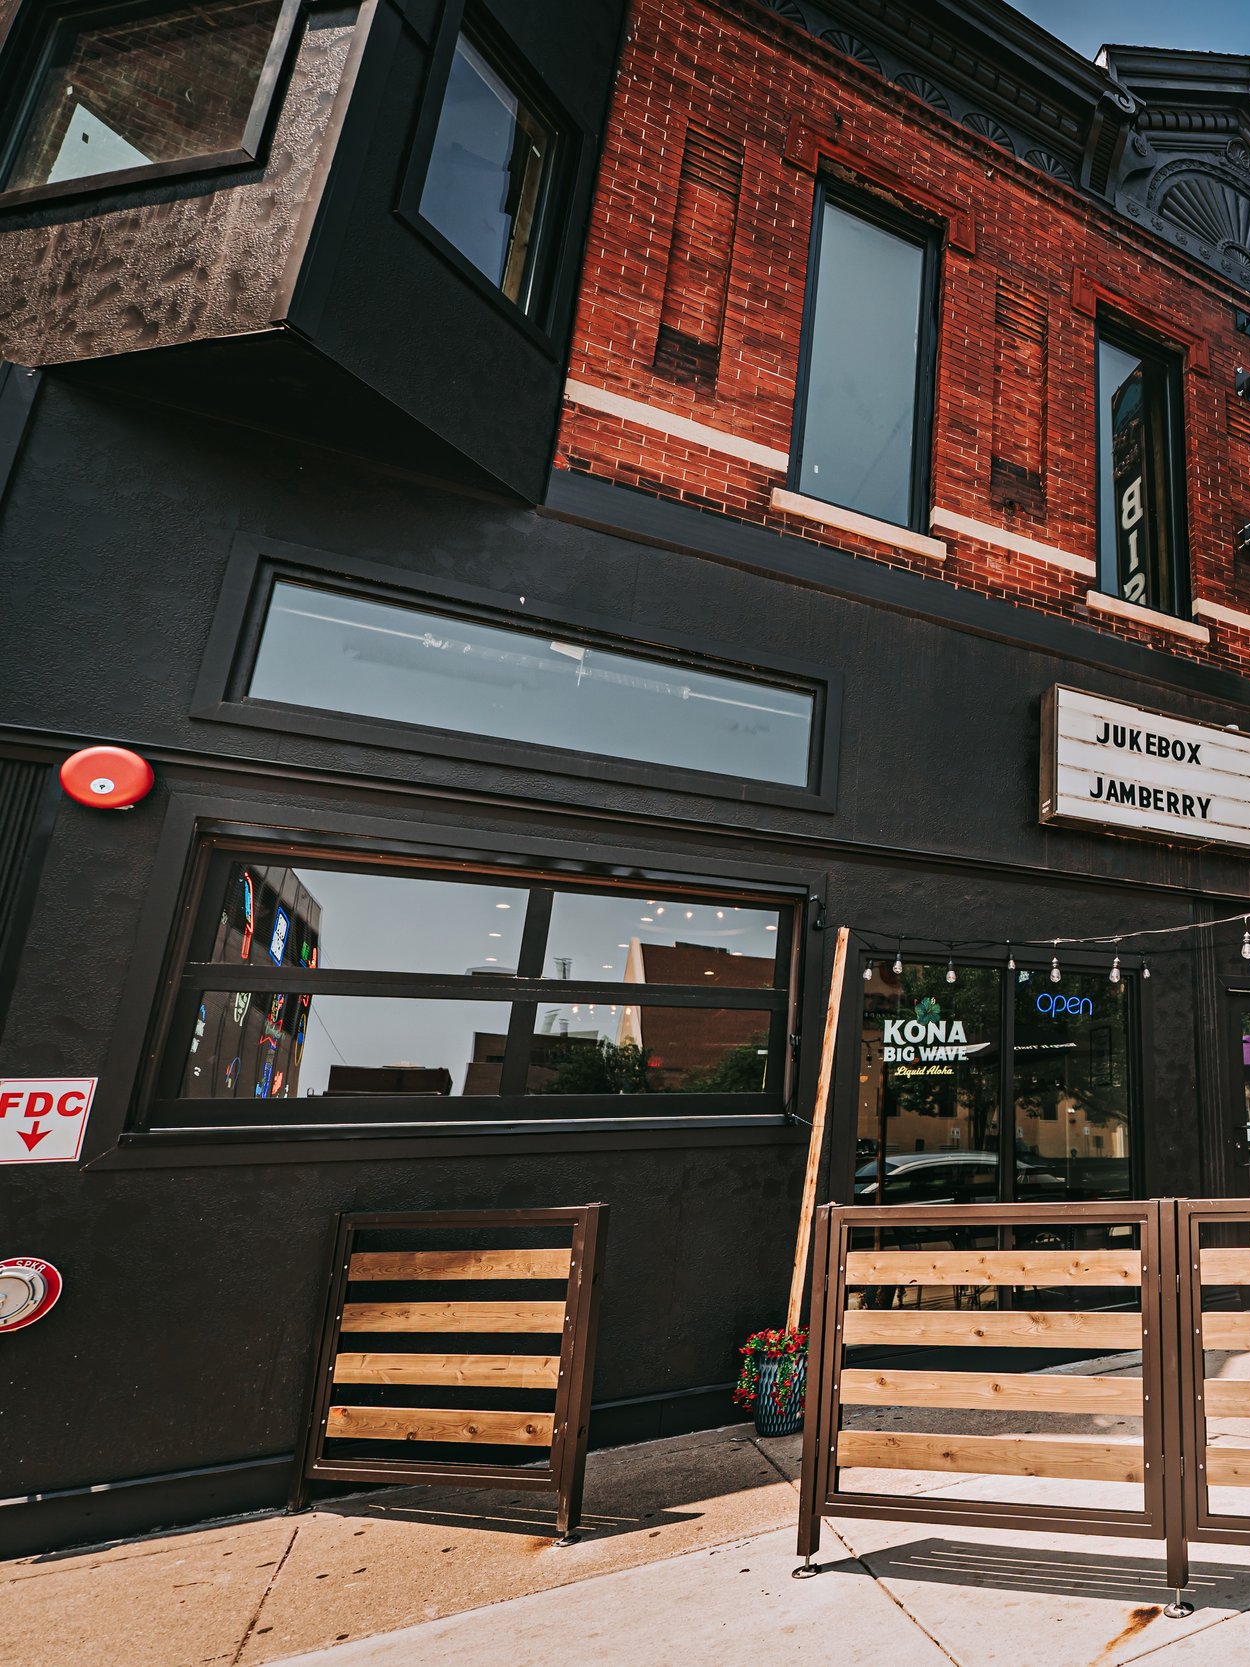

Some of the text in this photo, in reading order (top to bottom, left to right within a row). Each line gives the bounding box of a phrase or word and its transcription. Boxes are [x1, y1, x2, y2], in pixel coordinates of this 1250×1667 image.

[1096, 722, 1202, 765] JUKEBOX
[1089, 776, 1212, 819] JAMBERRY
[883, 1019, 968, 1045] KONA
[883, 1046, 915, 1062] BIG
[894, 1065, 927, 1078] Liquid
[0, 1091, 86, 1118] FDC
[16, 1260, 47, 1273] SPKR
